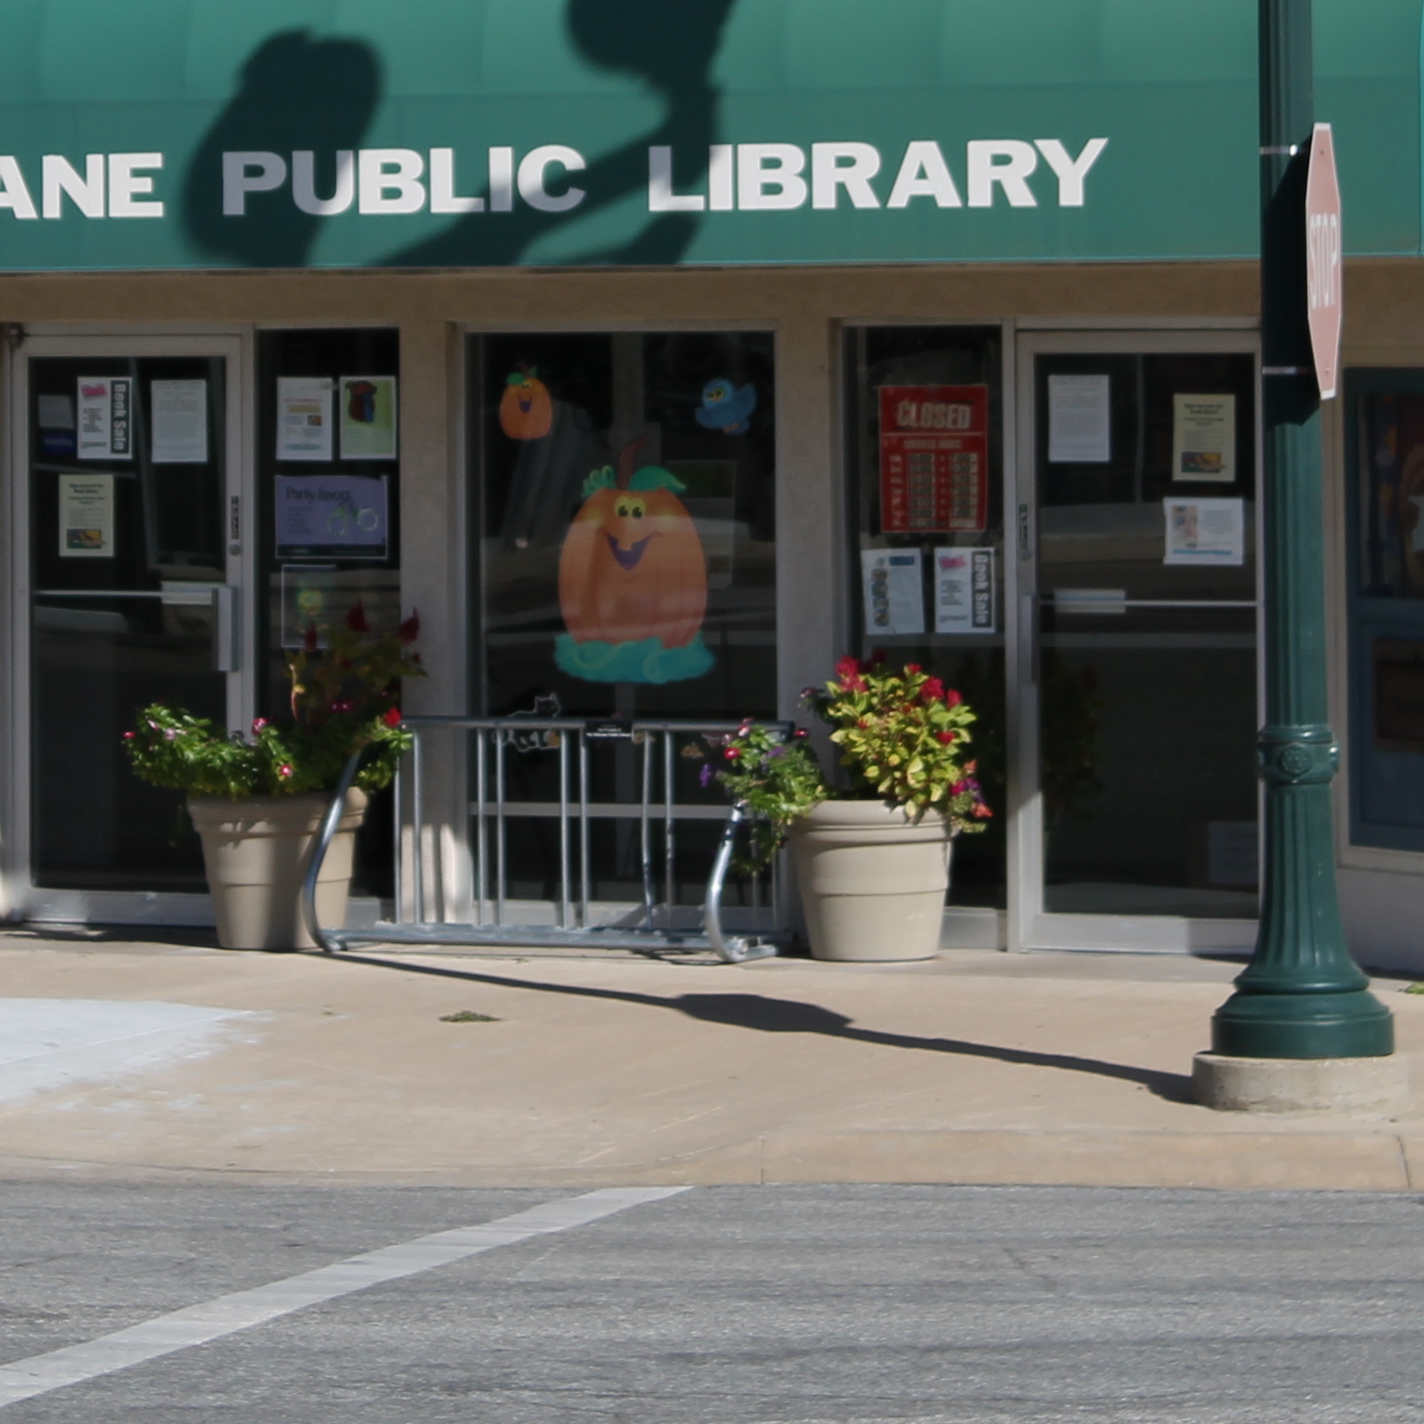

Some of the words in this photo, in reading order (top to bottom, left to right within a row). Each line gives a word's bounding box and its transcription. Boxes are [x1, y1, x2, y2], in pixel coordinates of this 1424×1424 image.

[221, 144, 586, 217] PUBLIC
[648, 137, 1109, 212] LIBRARY
[113, 383, 127, 418] Book
[896, 399, 972, 430] CLOSED
[113, 419, 127, 451] Sale
[974, 592, 989, 624] Sale
